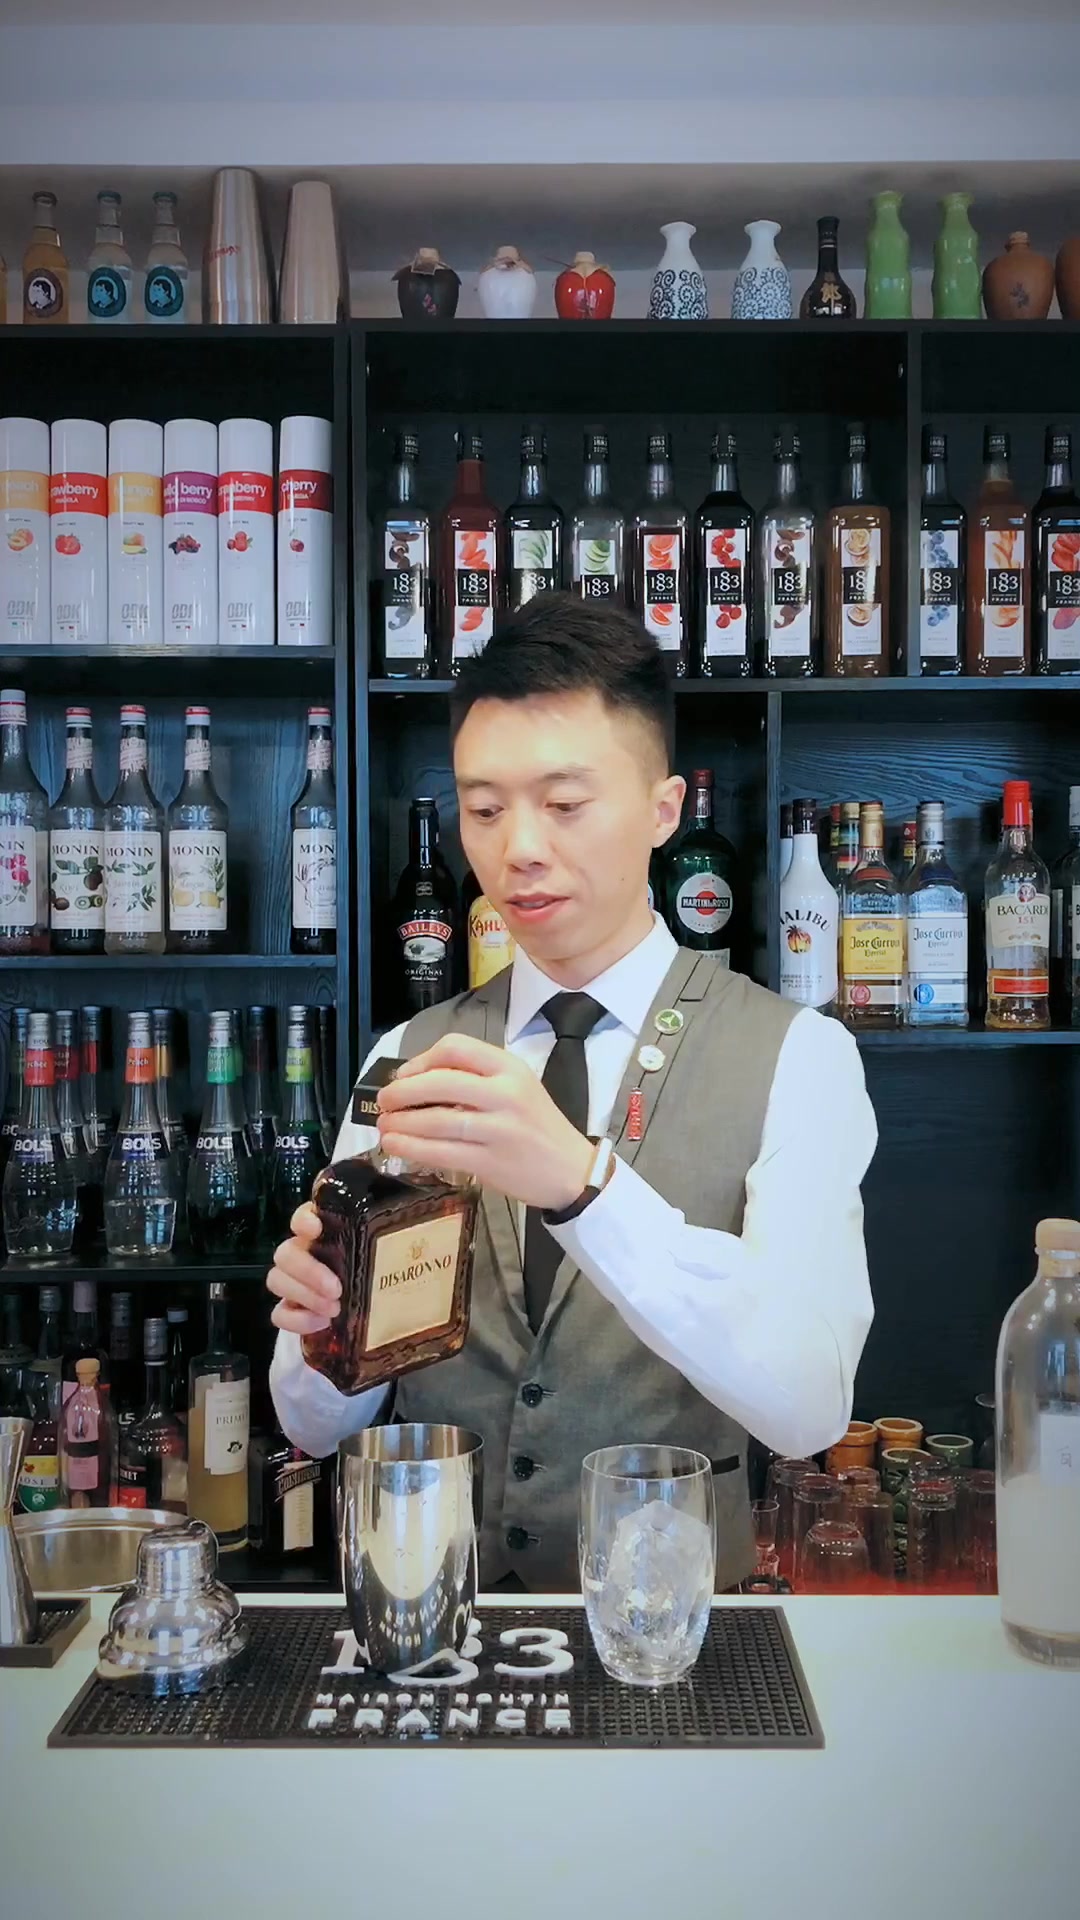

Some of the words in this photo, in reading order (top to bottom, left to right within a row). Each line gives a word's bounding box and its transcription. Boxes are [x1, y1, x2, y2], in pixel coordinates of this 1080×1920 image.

[181, 482, 212, 499] berry
[281, 479, 317, 493] cherry
[463, 573, 488, 594] 1883
[586, 577, 610, 597] 1883
[651, 572, 674, 592] 1883
[713, 571, 740, 592] 1883
[992, 572, 1018, 593] 1883
[52, 845, 100, 856] MONIN
[106, 847, 154, 857] MONIN
[173, 846, 221, 855] MONIN
[1018, 916, 1034, 924] 151
[402, 921, 450, 937] BAILEYS
[14, 1139, 53, 1152] BOLS
[122, 1138, 162, 1151] BOLS
[196, 1136, 233, 1149] BOLS
[275, 1135, 310, 1148] BOLS
[379, 1255, 452, 1290] DISARONNO
[307, 1707, 573, 1729] FRANCE
